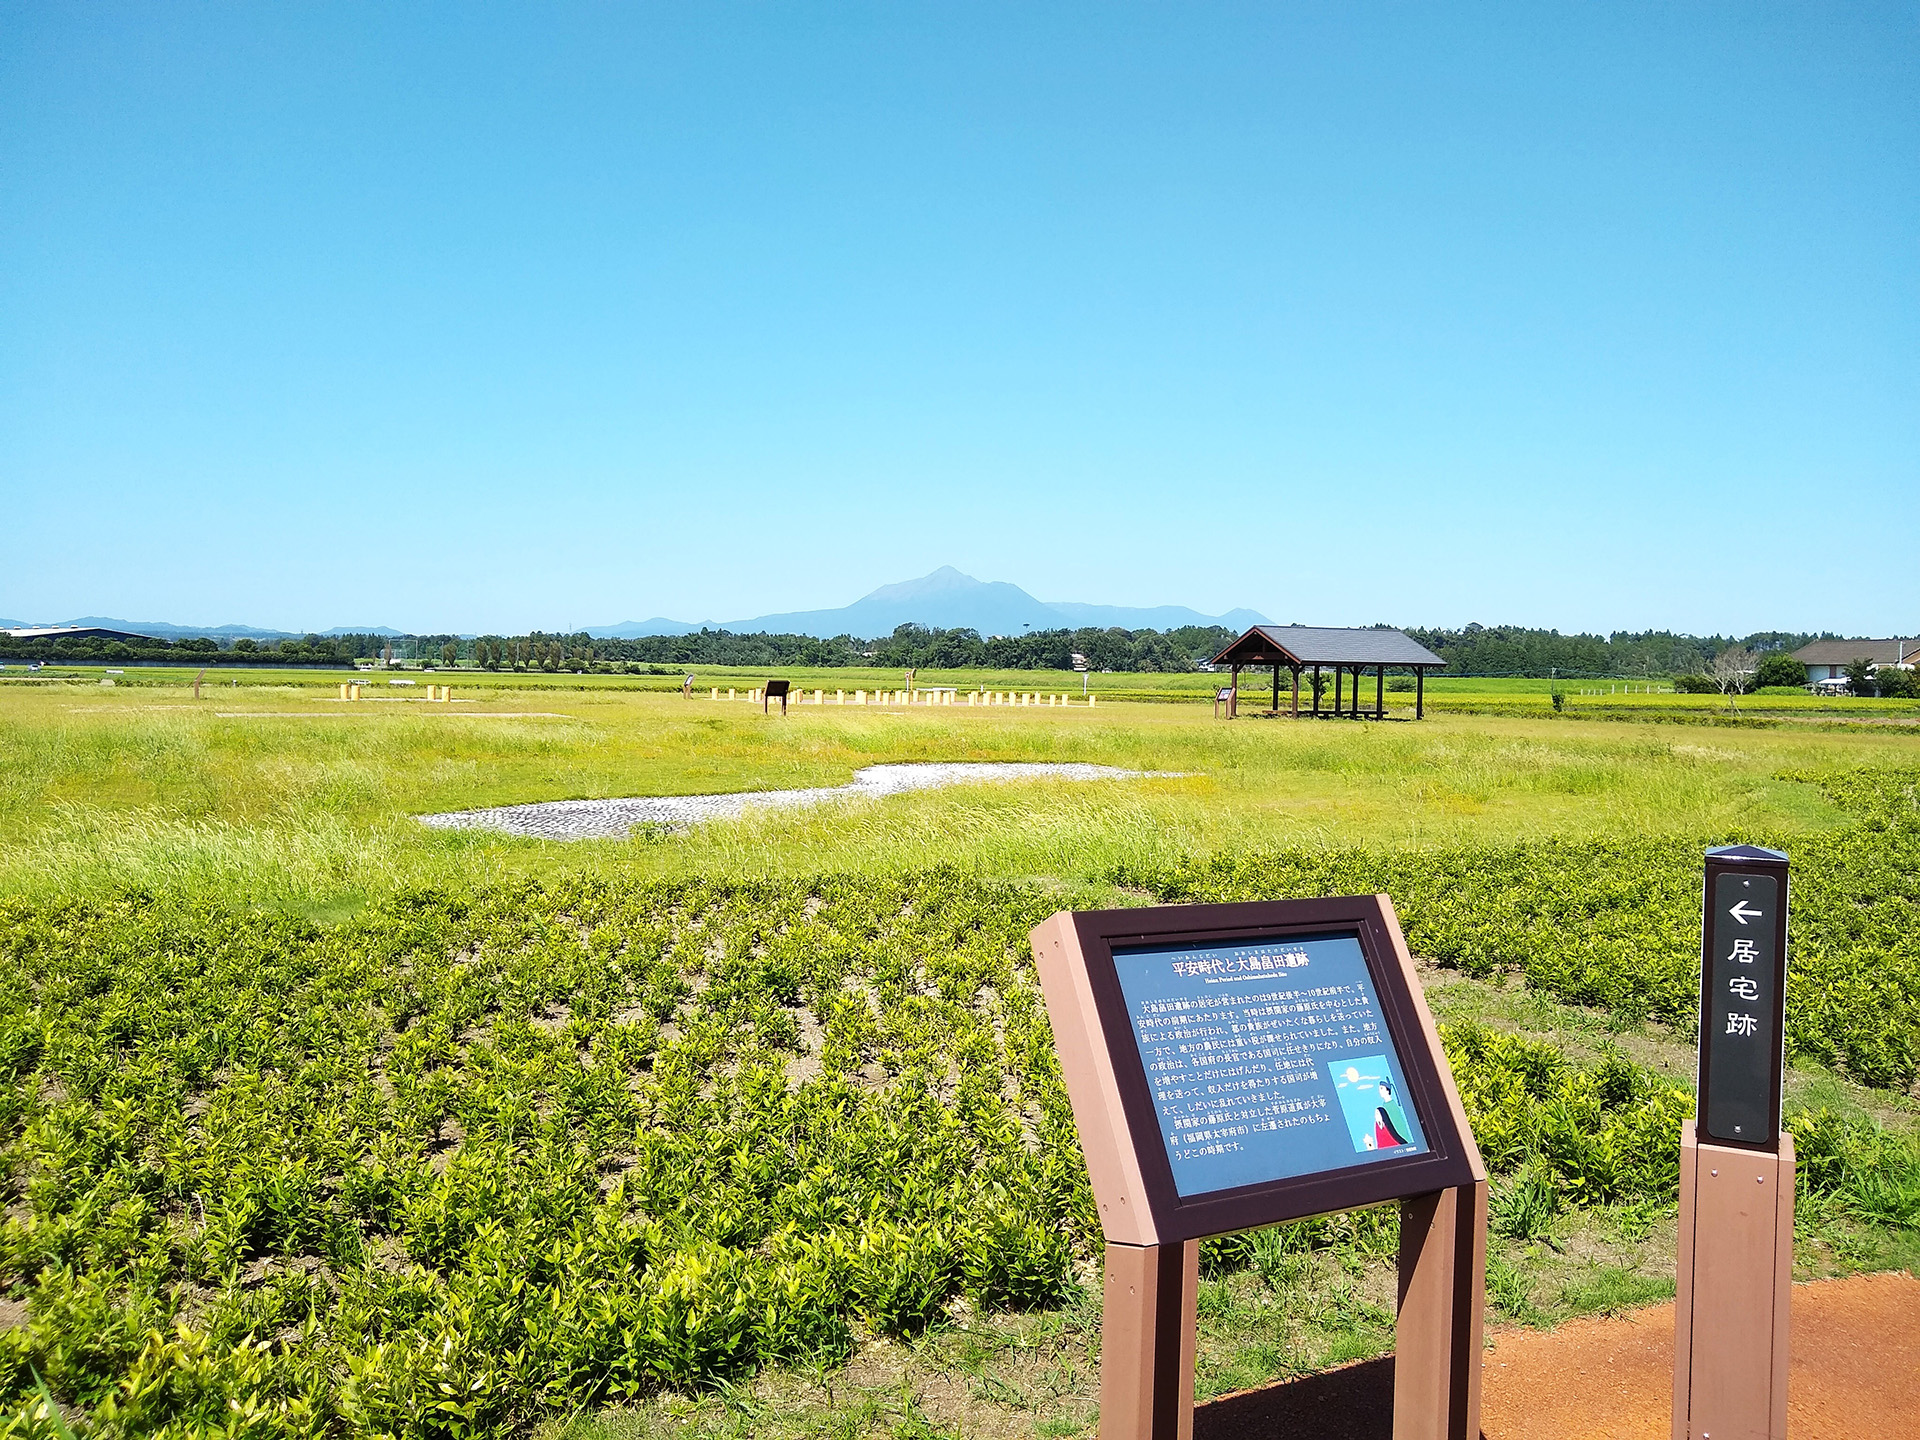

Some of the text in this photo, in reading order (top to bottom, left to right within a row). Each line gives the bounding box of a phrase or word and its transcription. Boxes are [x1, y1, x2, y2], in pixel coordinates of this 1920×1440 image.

[1171, 951, 1310, 978] 平安時代と大島畠田遺跡
[1726, 938, 1760, 1037] 居宅跡
[1175, 1141, 1244, 1160] うどこの時期です。
